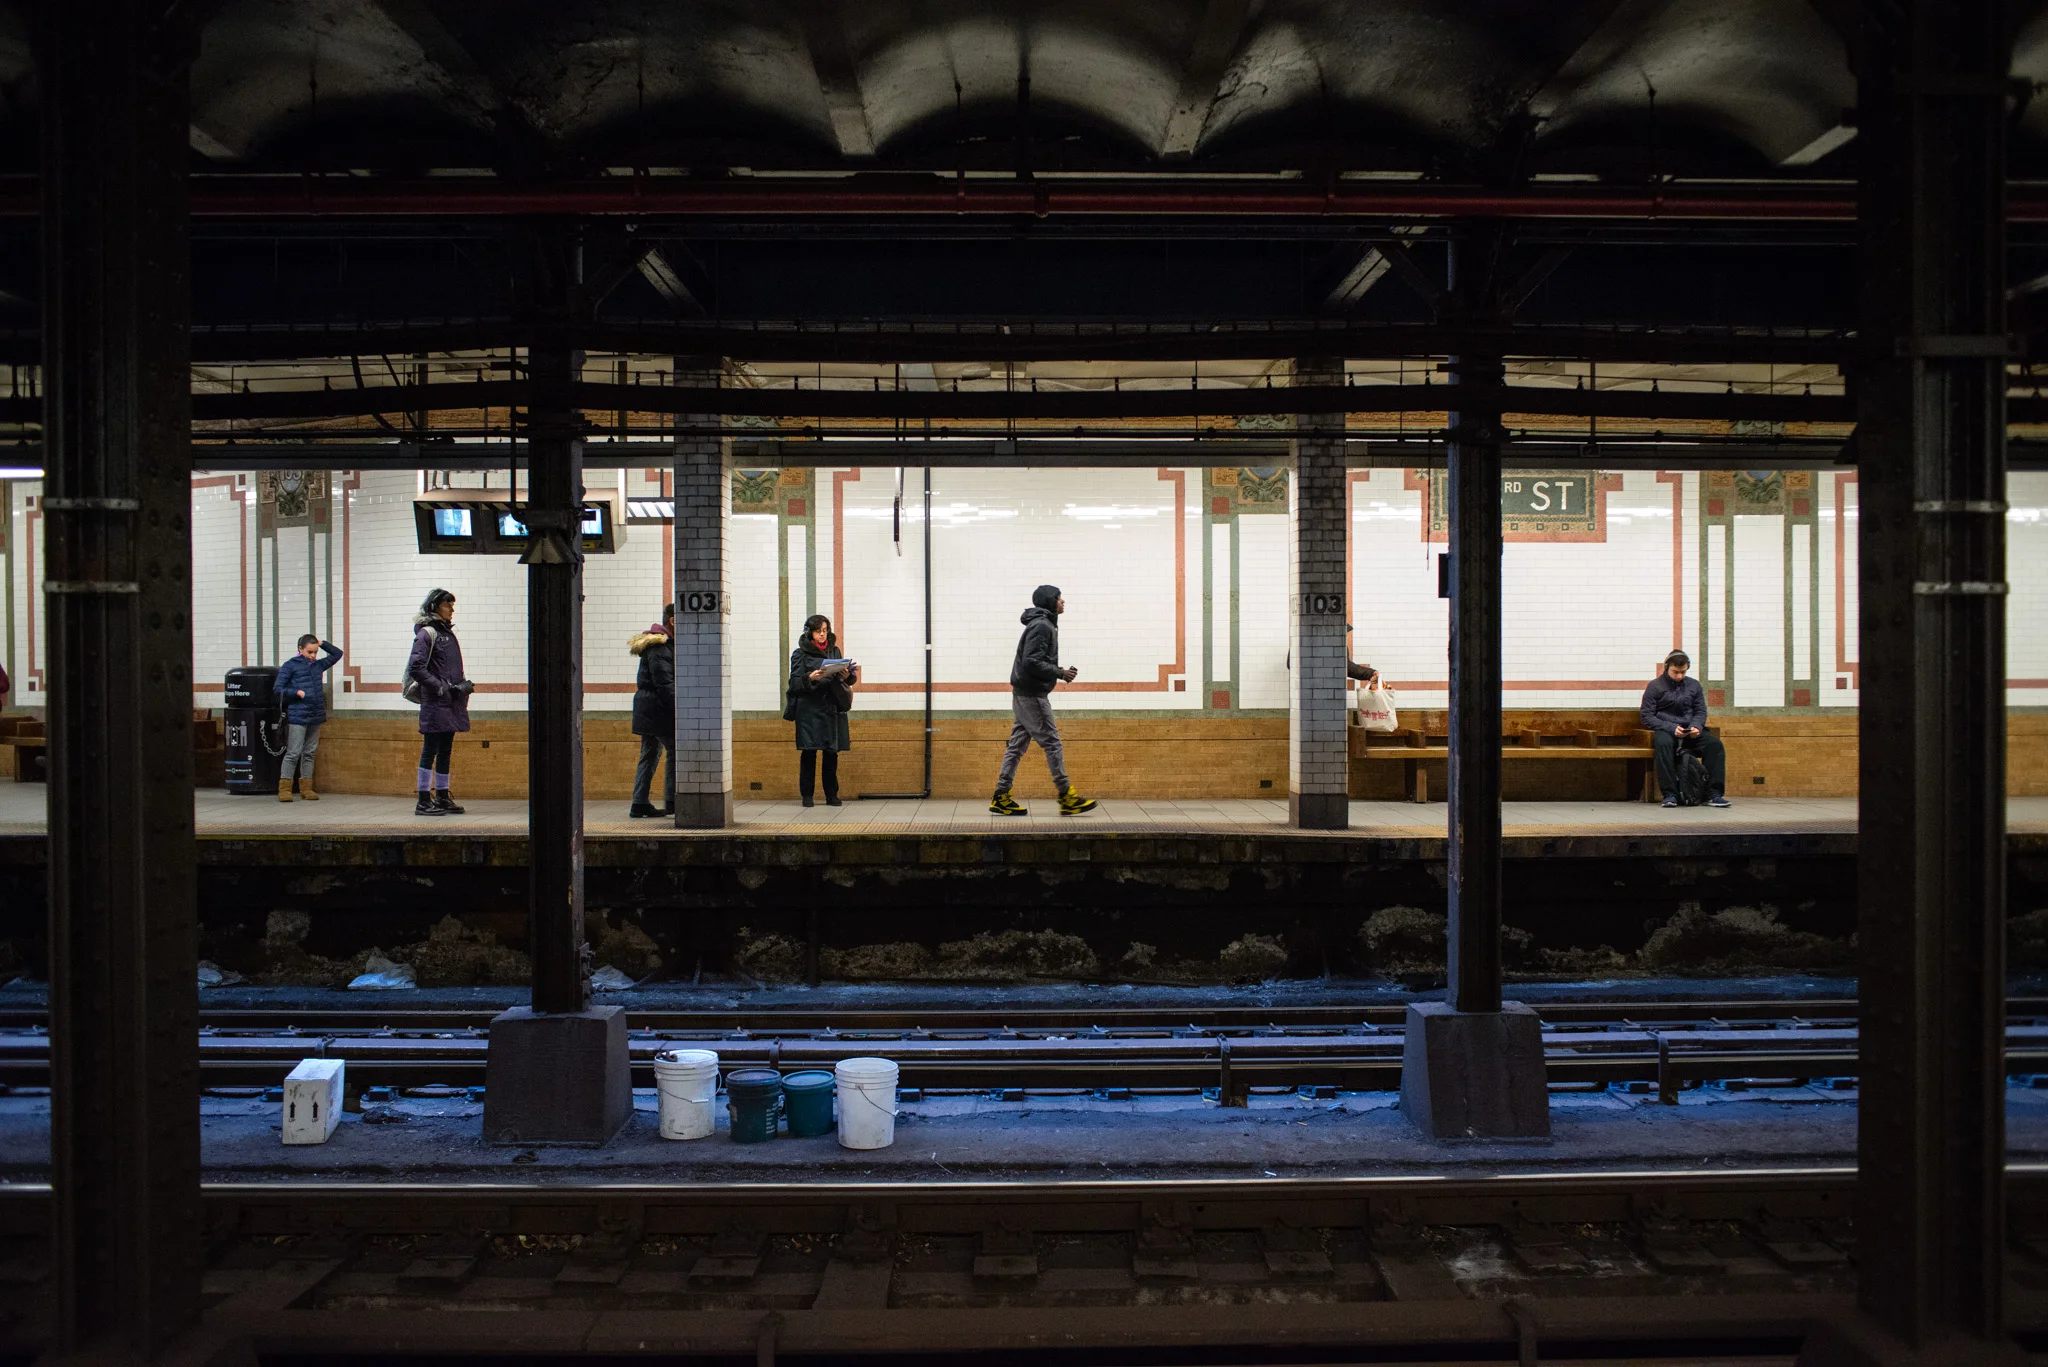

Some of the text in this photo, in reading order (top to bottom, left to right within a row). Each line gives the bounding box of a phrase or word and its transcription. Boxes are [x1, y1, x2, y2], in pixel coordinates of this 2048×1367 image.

[1530, 481, 1574, 511] ST
[679, 592, 717, 612] 103
[1304, 594, 1342, 614] 103
